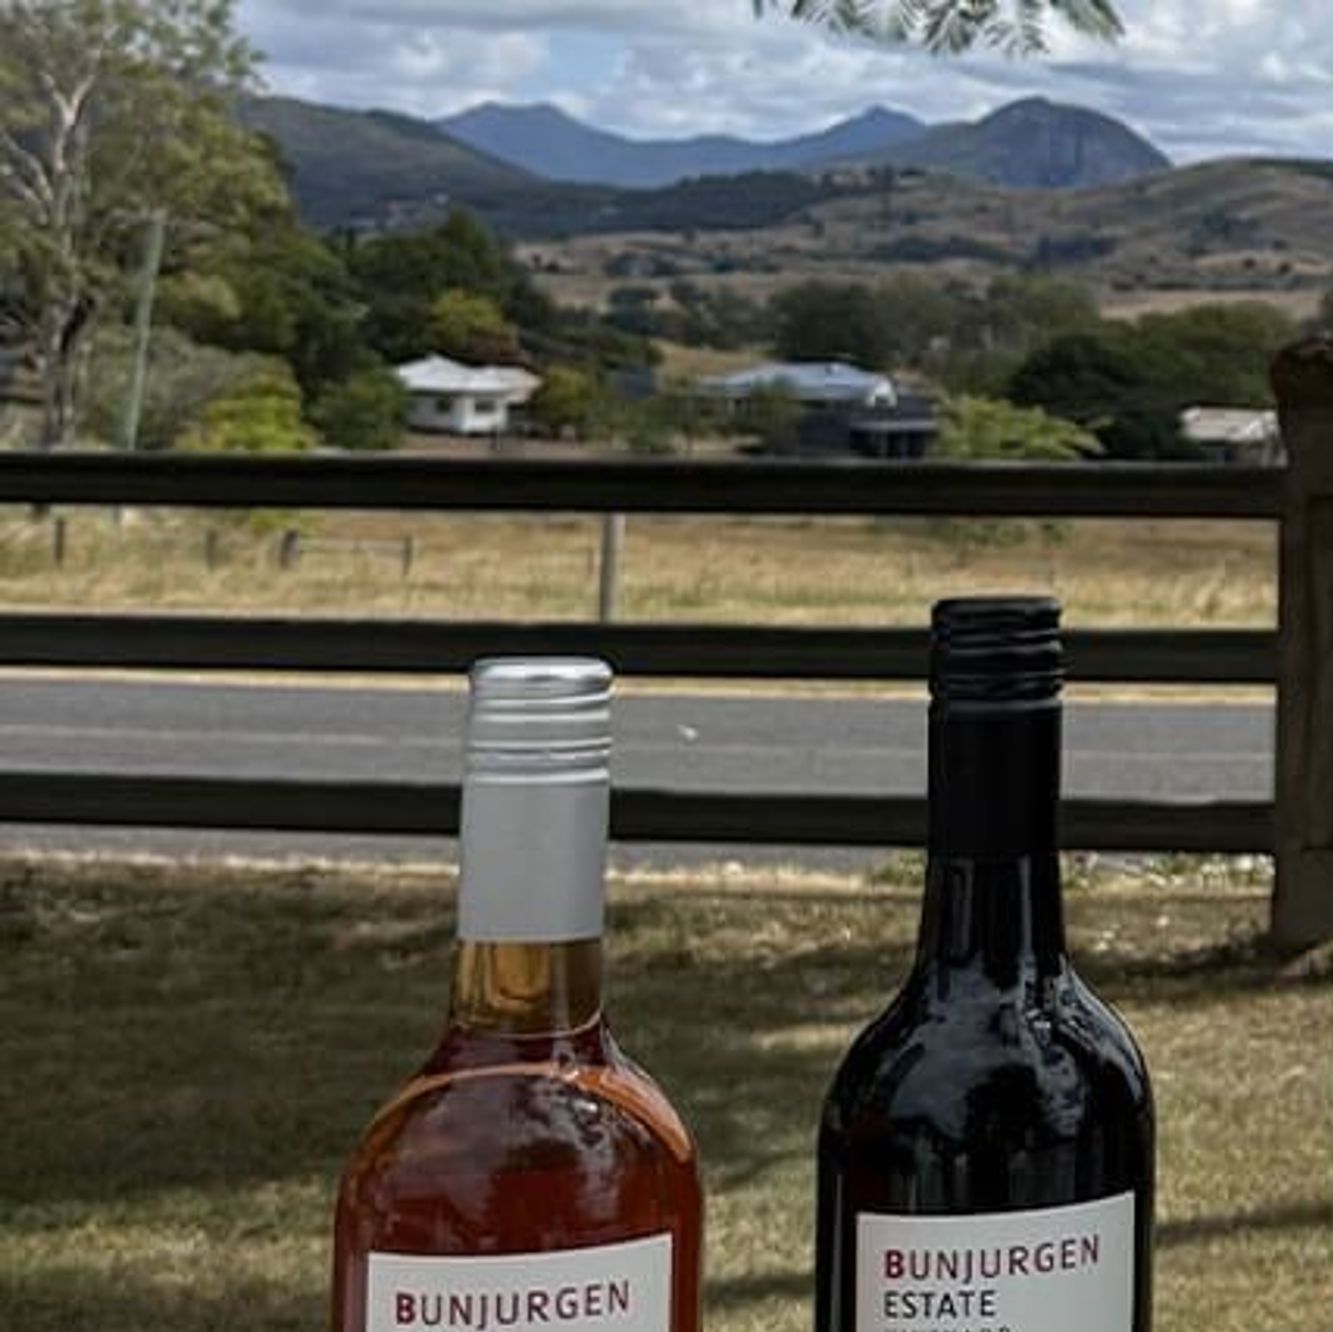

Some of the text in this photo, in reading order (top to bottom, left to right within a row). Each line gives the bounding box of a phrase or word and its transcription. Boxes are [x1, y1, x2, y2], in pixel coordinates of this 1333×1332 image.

[884, 1234, 1100, 1284] BUNJURGEN
[395, 1280, 631, 1330] BUNJURGEN
[884, 1290, 997, 1319] ESTATE
